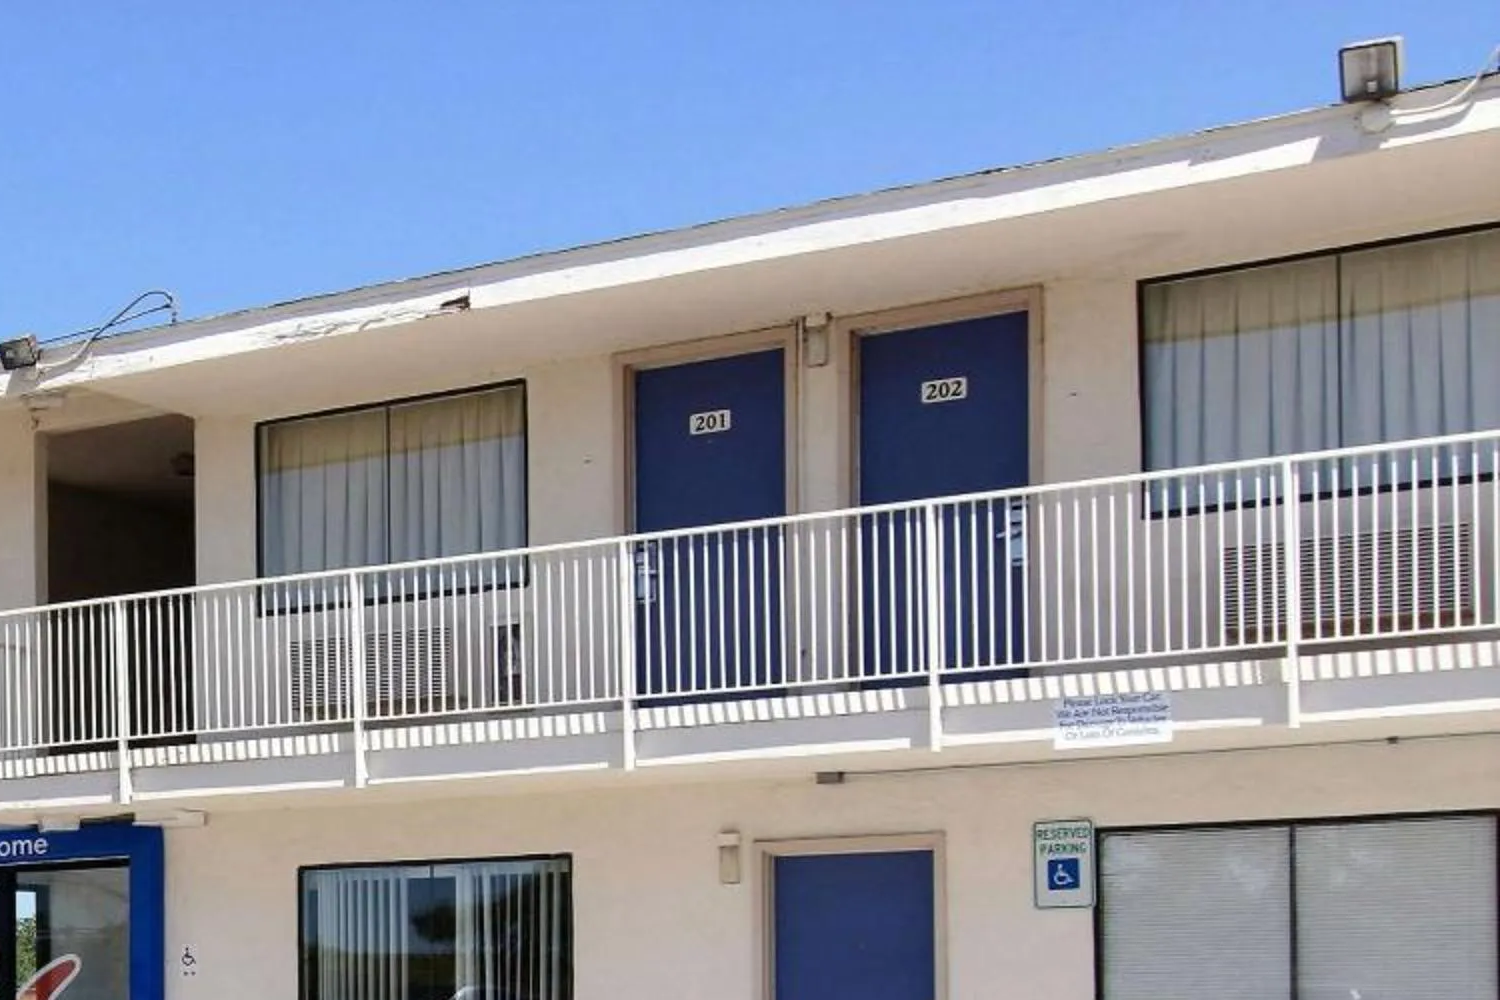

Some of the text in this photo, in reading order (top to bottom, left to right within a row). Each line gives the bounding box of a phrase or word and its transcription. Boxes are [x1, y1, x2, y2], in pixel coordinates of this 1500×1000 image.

[926, 380, 963, 400] 202
[695, 412, 727, 432] 201
[1037, 826, 1091, 841] RESERVED
[1040, 842, 1087, 855] PARKING
